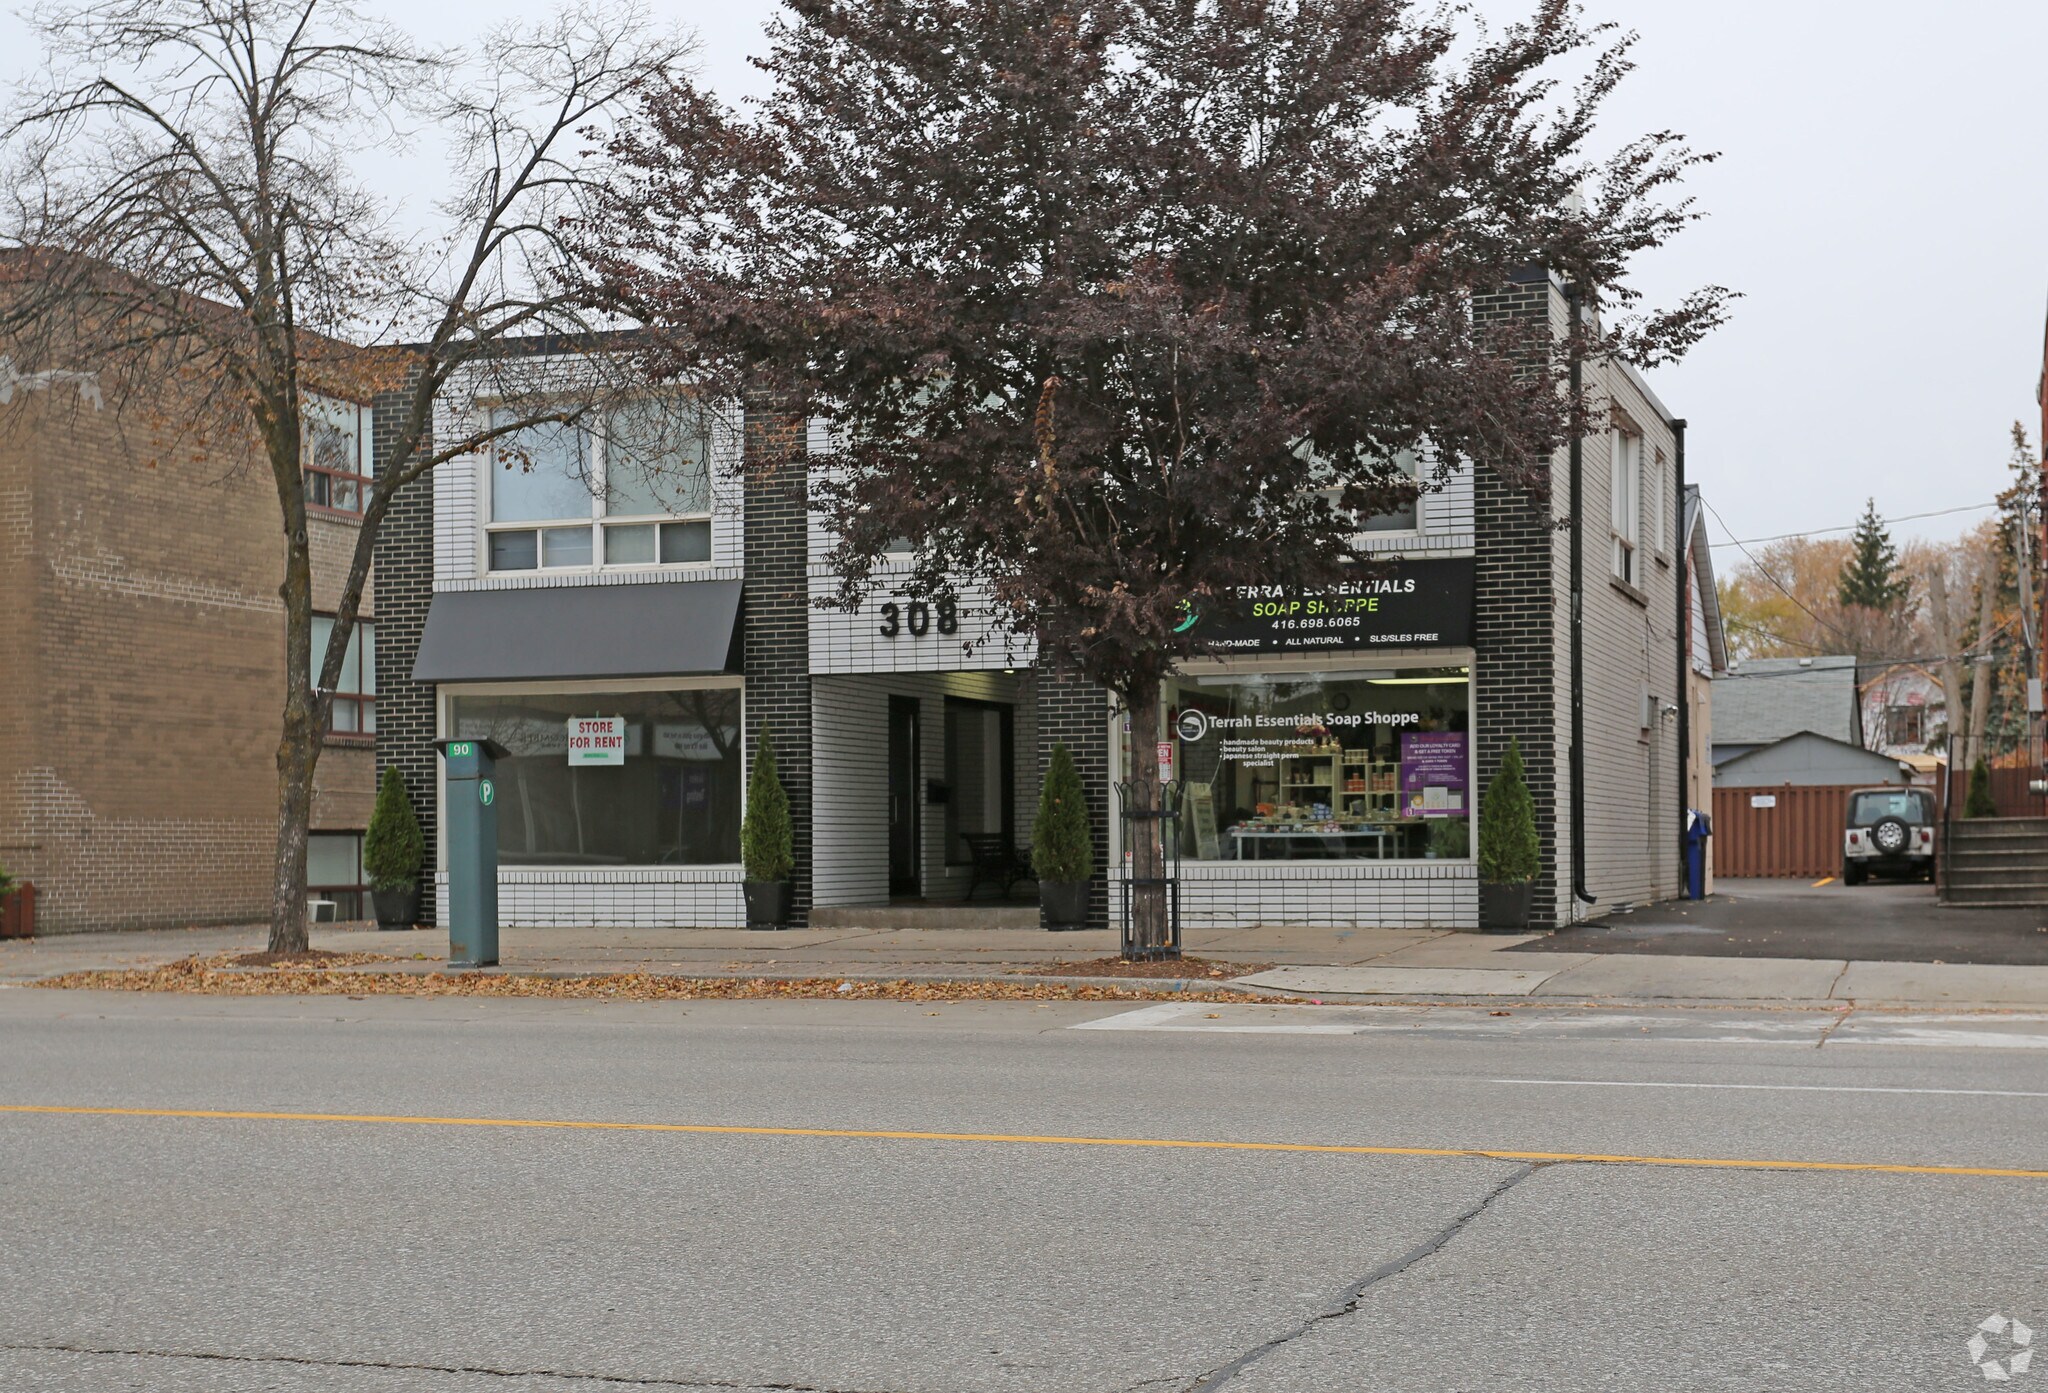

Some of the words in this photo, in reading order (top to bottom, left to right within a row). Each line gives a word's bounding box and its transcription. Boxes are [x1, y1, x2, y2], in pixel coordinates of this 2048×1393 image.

[1252, 601, 1301, 617] SOAP
[1306, 597, 1379, 615] SHPPE
[880, 601, 958, 637] 308
[1271, 616, 1361, 630] 416.698.6065
[1285, 638, 1302, 646] ALL
[1303, 636, 1344, 645] NATURAL
[1369, 634, 1412, 643] SLS/SLES
[1413, 633, 1439, 641] FREE
[1208, 715, 1252, 728] Terrah
[1255, 713, 1323, 727] Essentials
[1326, 713, 1361, 728] Soap
[1364, 711, 1419, 727] Shoppe
[578, 721, 614, 734] STORE
[569, 736, 591, 749] FOR
[595, 736, 623, 749] RENT
[1259, 739, 1283, 747] beauty
[1284, 738, 1314, 746] products
[453, 744, 469, 755] 90
[1223, 745, 1246, 754] beauty
[1223, 752, 1253, 760] japanese
[1254, 751, 1280, 760] straight
[1281, 752, 1299, 760] perm
[1243, 759, 1274, 768] specialist
